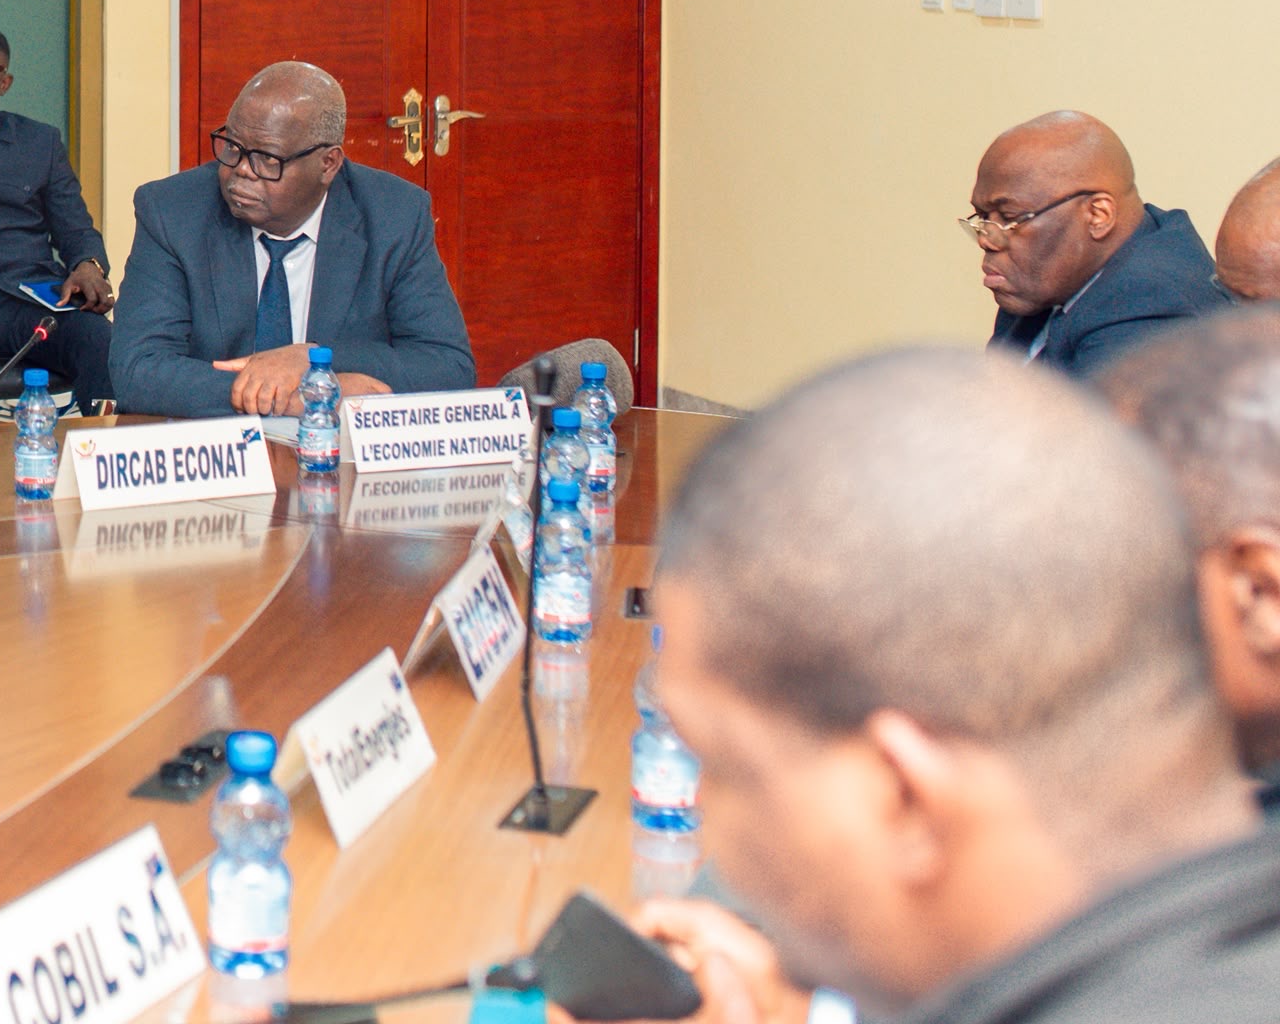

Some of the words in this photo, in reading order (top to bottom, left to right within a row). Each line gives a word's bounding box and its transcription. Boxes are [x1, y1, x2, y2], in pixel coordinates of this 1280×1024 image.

[354, 407, 440, 429] SECRETAIRE
[444, 403, 507, 423] GENERAL
[96, 449, 167, 489] DIRCAB
[172, 442, 247, 482] ECONAT
[362, 439, 445, 462] L'ECONOMIE
[449, 433, 526, 456] NATIONALE
[8, 926, 119, 1024] COBIL
[118, 887, 187, 979] S.A.
